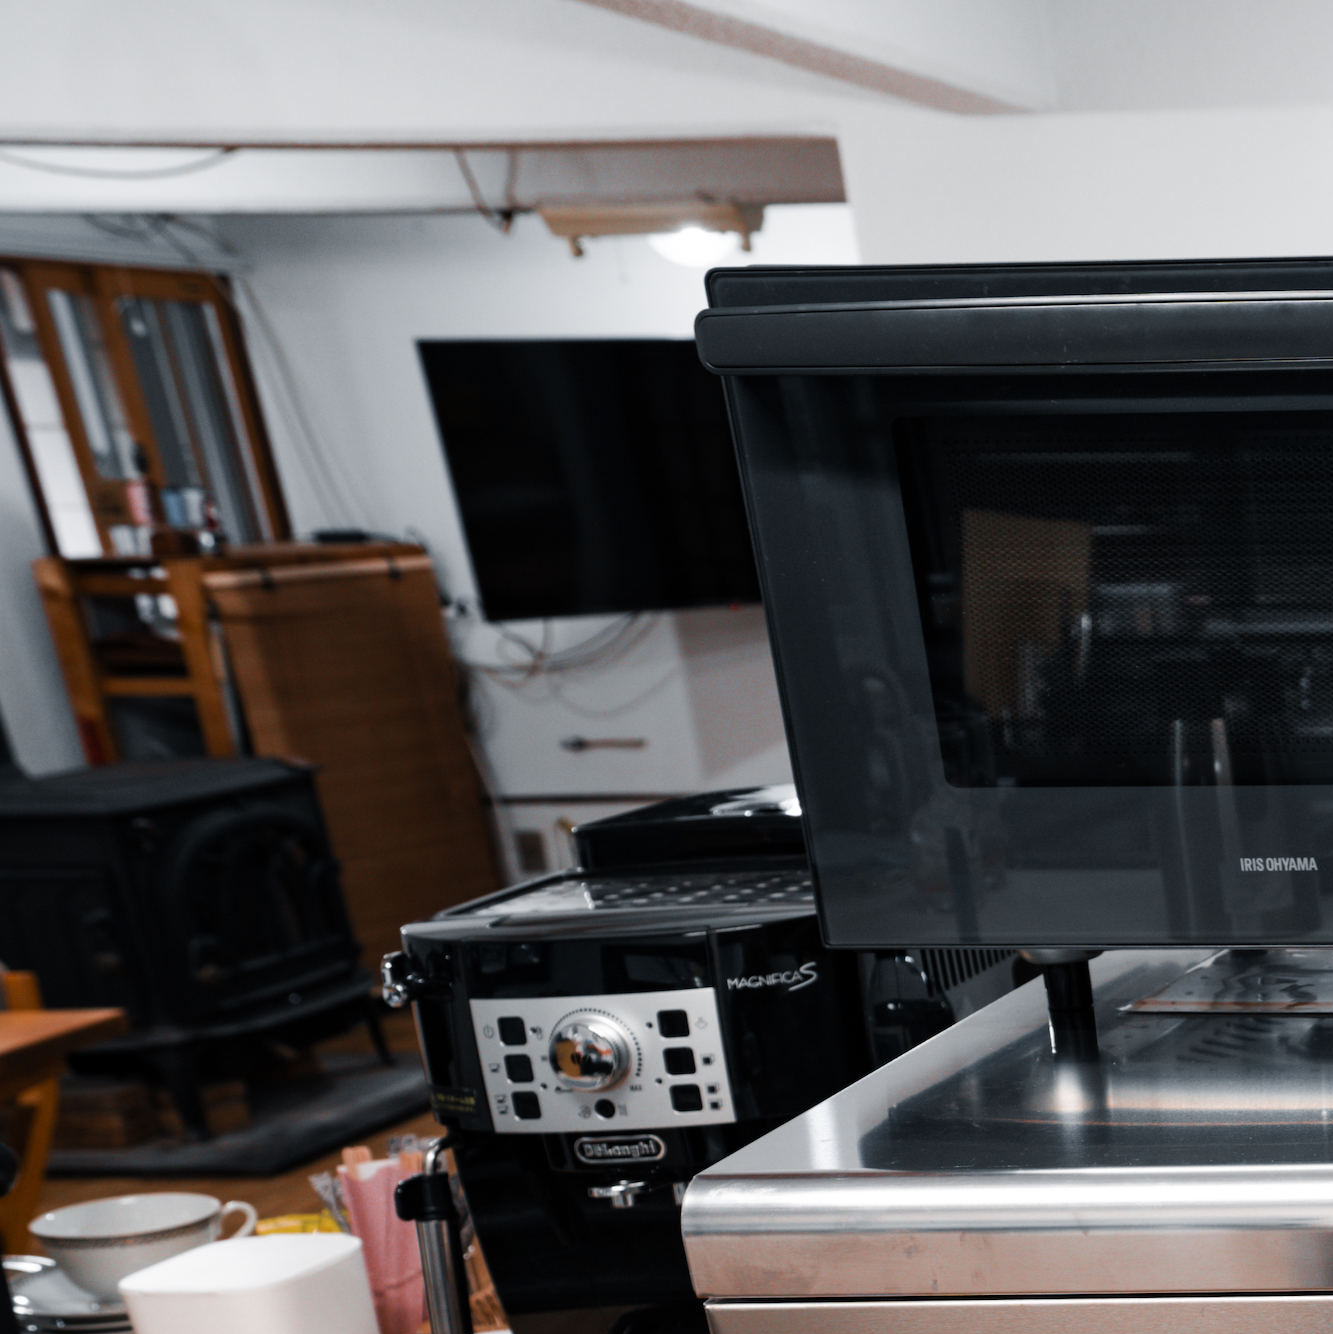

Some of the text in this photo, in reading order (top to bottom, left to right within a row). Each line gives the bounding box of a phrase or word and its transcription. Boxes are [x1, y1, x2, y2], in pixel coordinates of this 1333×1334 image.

[1240, 857, 1318, 871] IRIS OHYAMA
[727, 961, 818, 992] MAGNIFICA S
